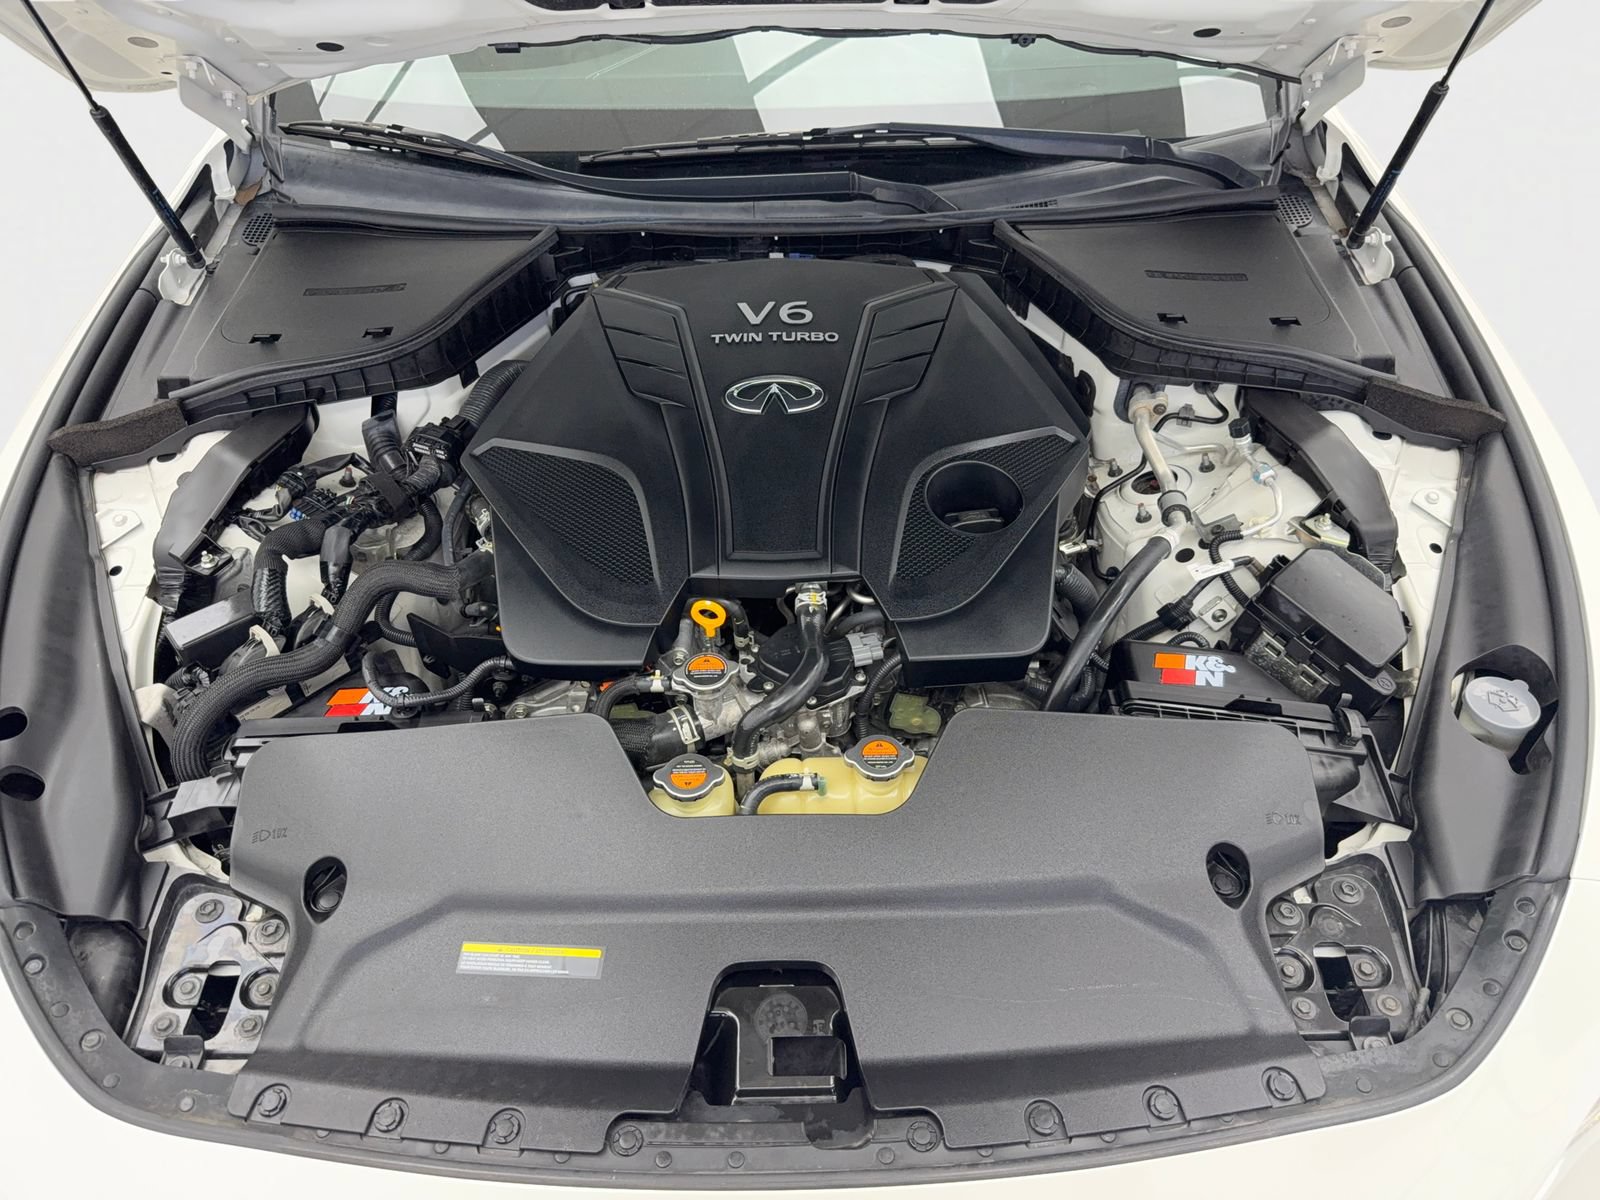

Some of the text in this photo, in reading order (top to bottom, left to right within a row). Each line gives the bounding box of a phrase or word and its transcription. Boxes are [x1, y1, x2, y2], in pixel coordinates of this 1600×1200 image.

[736, 301, 813, 325] V6
[711, 331, 839, 344] TWIN TURBO
